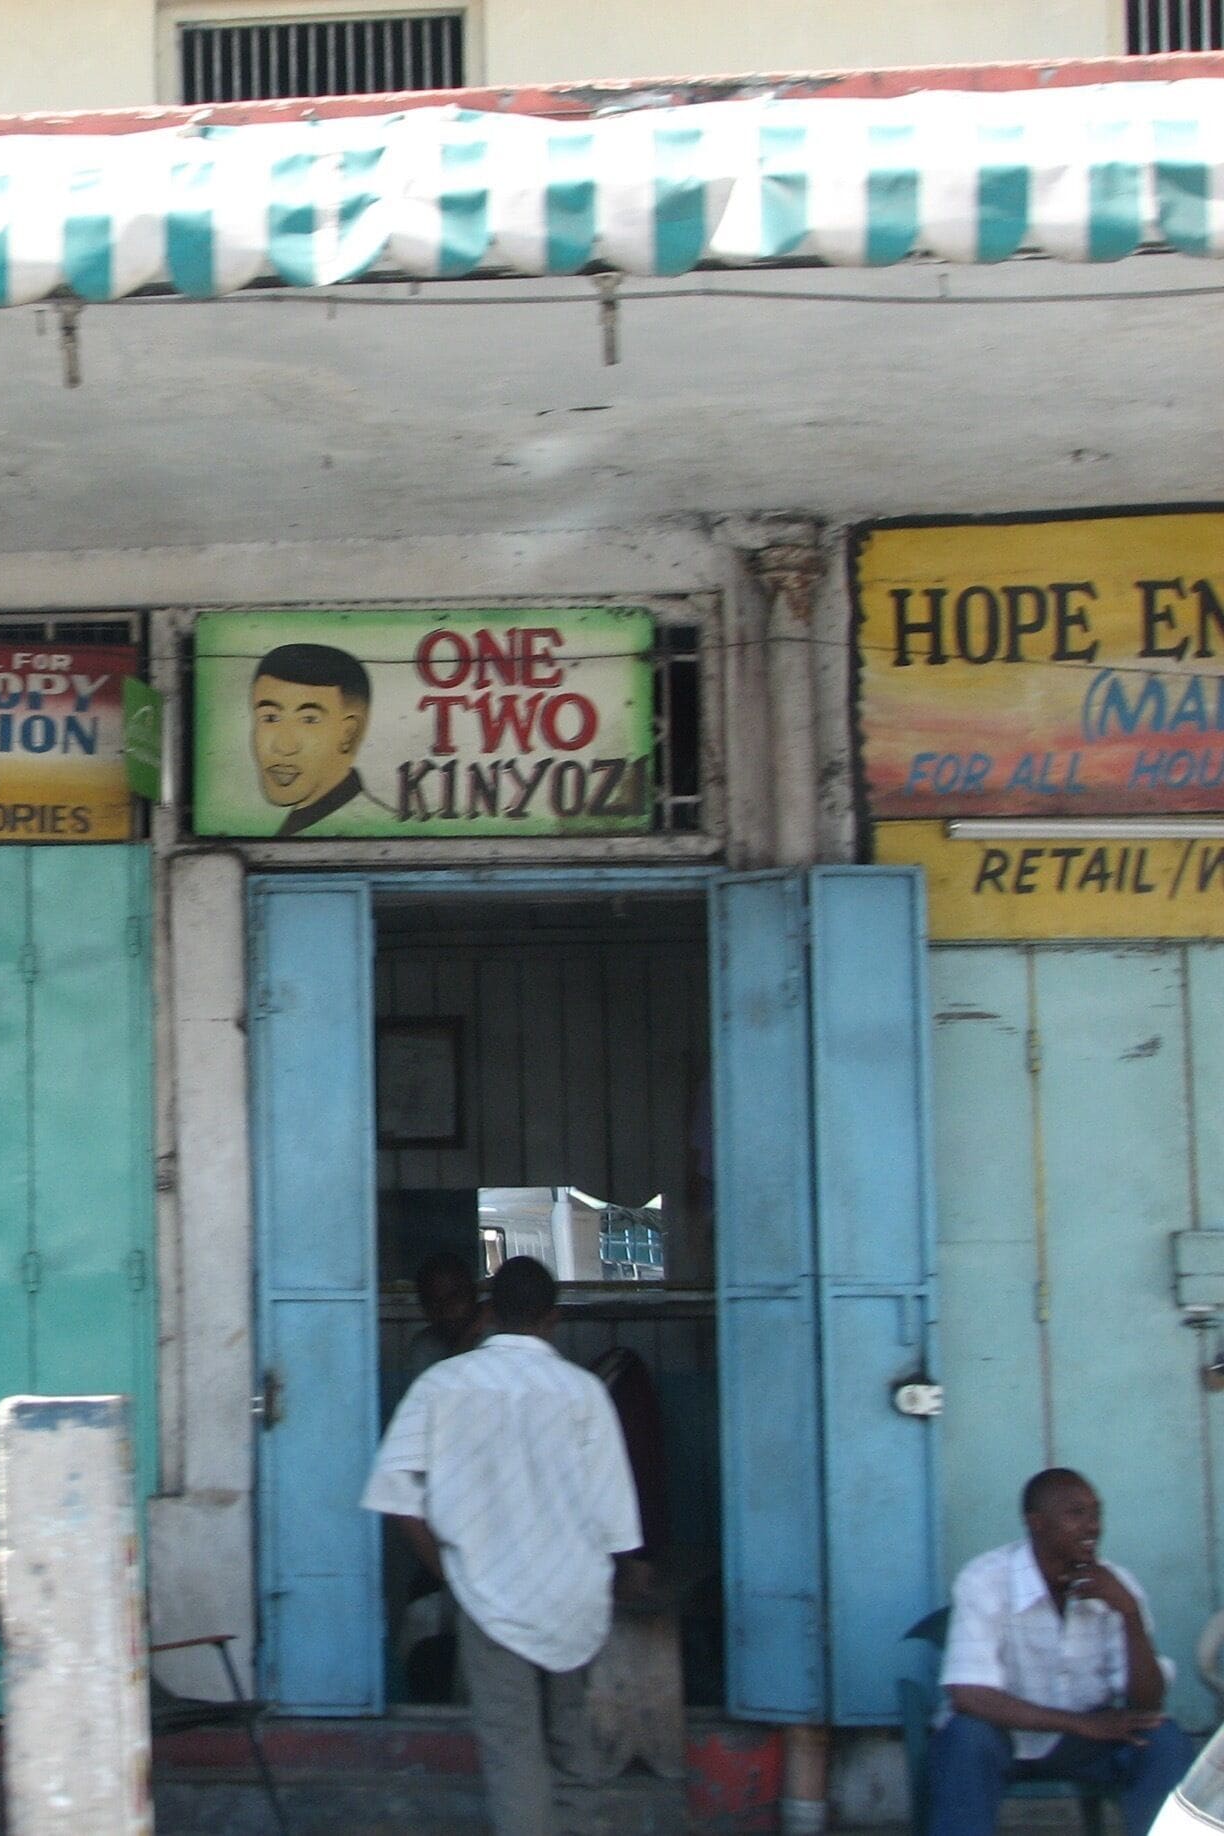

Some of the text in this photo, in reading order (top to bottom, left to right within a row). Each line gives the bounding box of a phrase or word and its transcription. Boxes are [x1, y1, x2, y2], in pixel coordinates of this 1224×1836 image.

[889, 582, 1097, 666] HOPE
[11, 653, 73, 672] FOR
[416, 627, 564, 689] ONE
[418, 692, 598, 755] TWO
[1083, 667, 1224, 743] (MA
[903, 753, 993, 797] FOR
[1004, 752, 1086, 795] ALL
